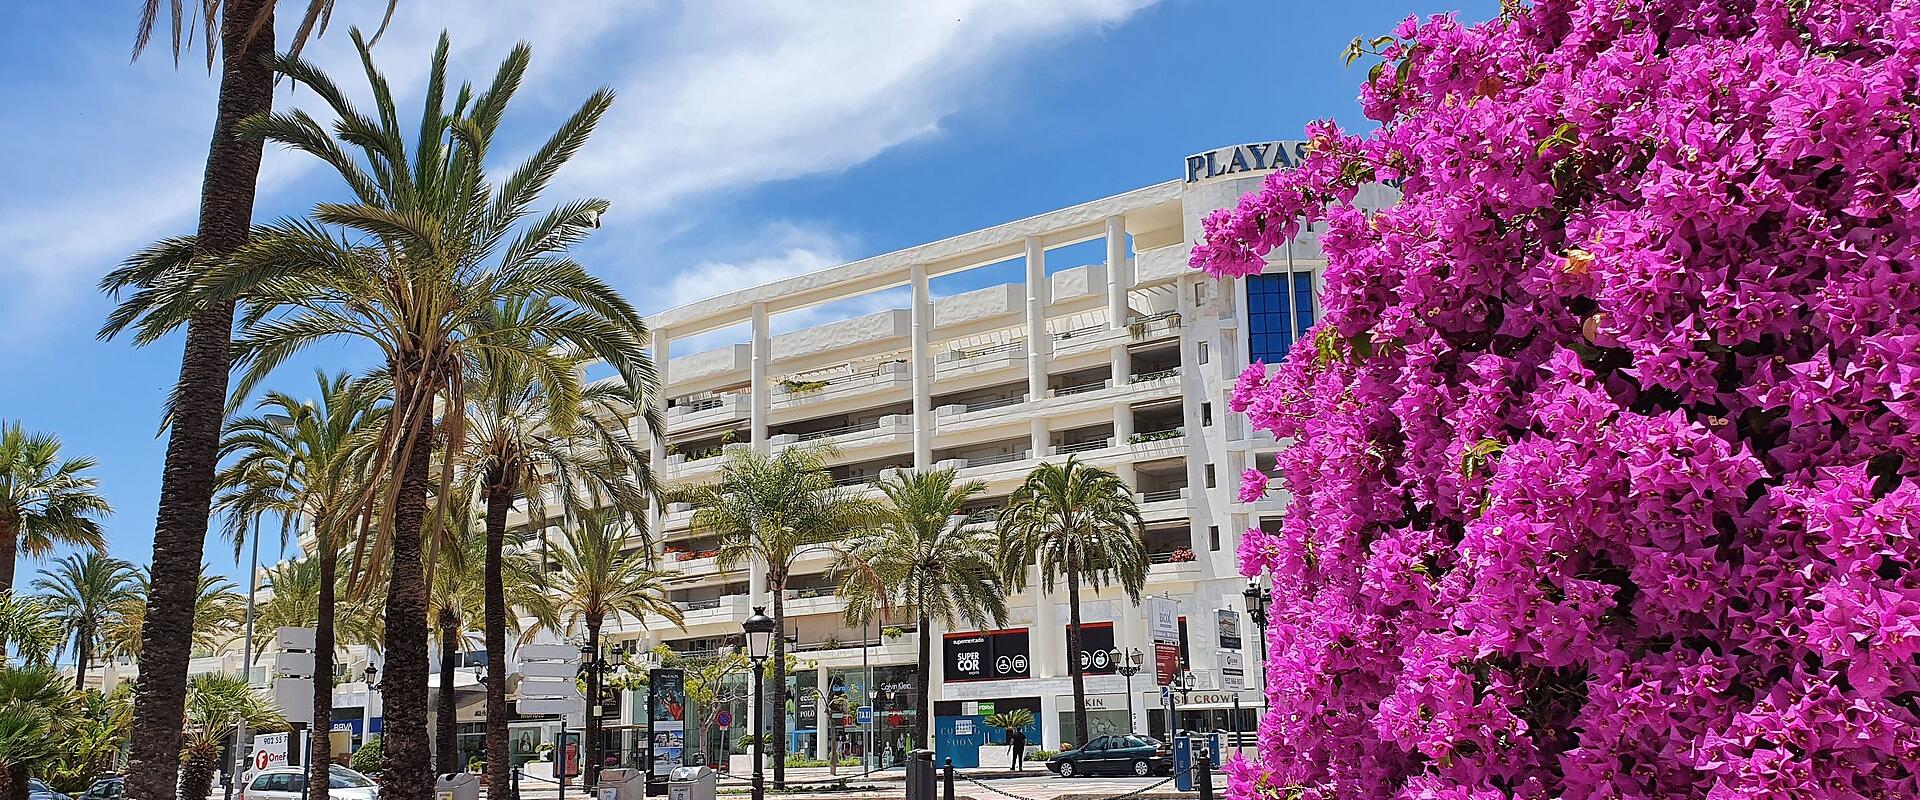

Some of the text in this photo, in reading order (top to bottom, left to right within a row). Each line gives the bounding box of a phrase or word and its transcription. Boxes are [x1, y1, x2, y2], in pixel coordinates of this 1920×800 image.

[1186, 142, 1307, 183] PLAYAS
[957, 651, 980, 661] SUPER
[957, 660, 980, 672] COR
[1194, 694, 1234, 704] CROW
[858, 711, 871, 719] TAXI
[333, 722, 353, 730] BBVA
[941, 726, 981, 735] COG
[263, 737, 275, 745] 902
[946, 737, 974, 746] SOON
